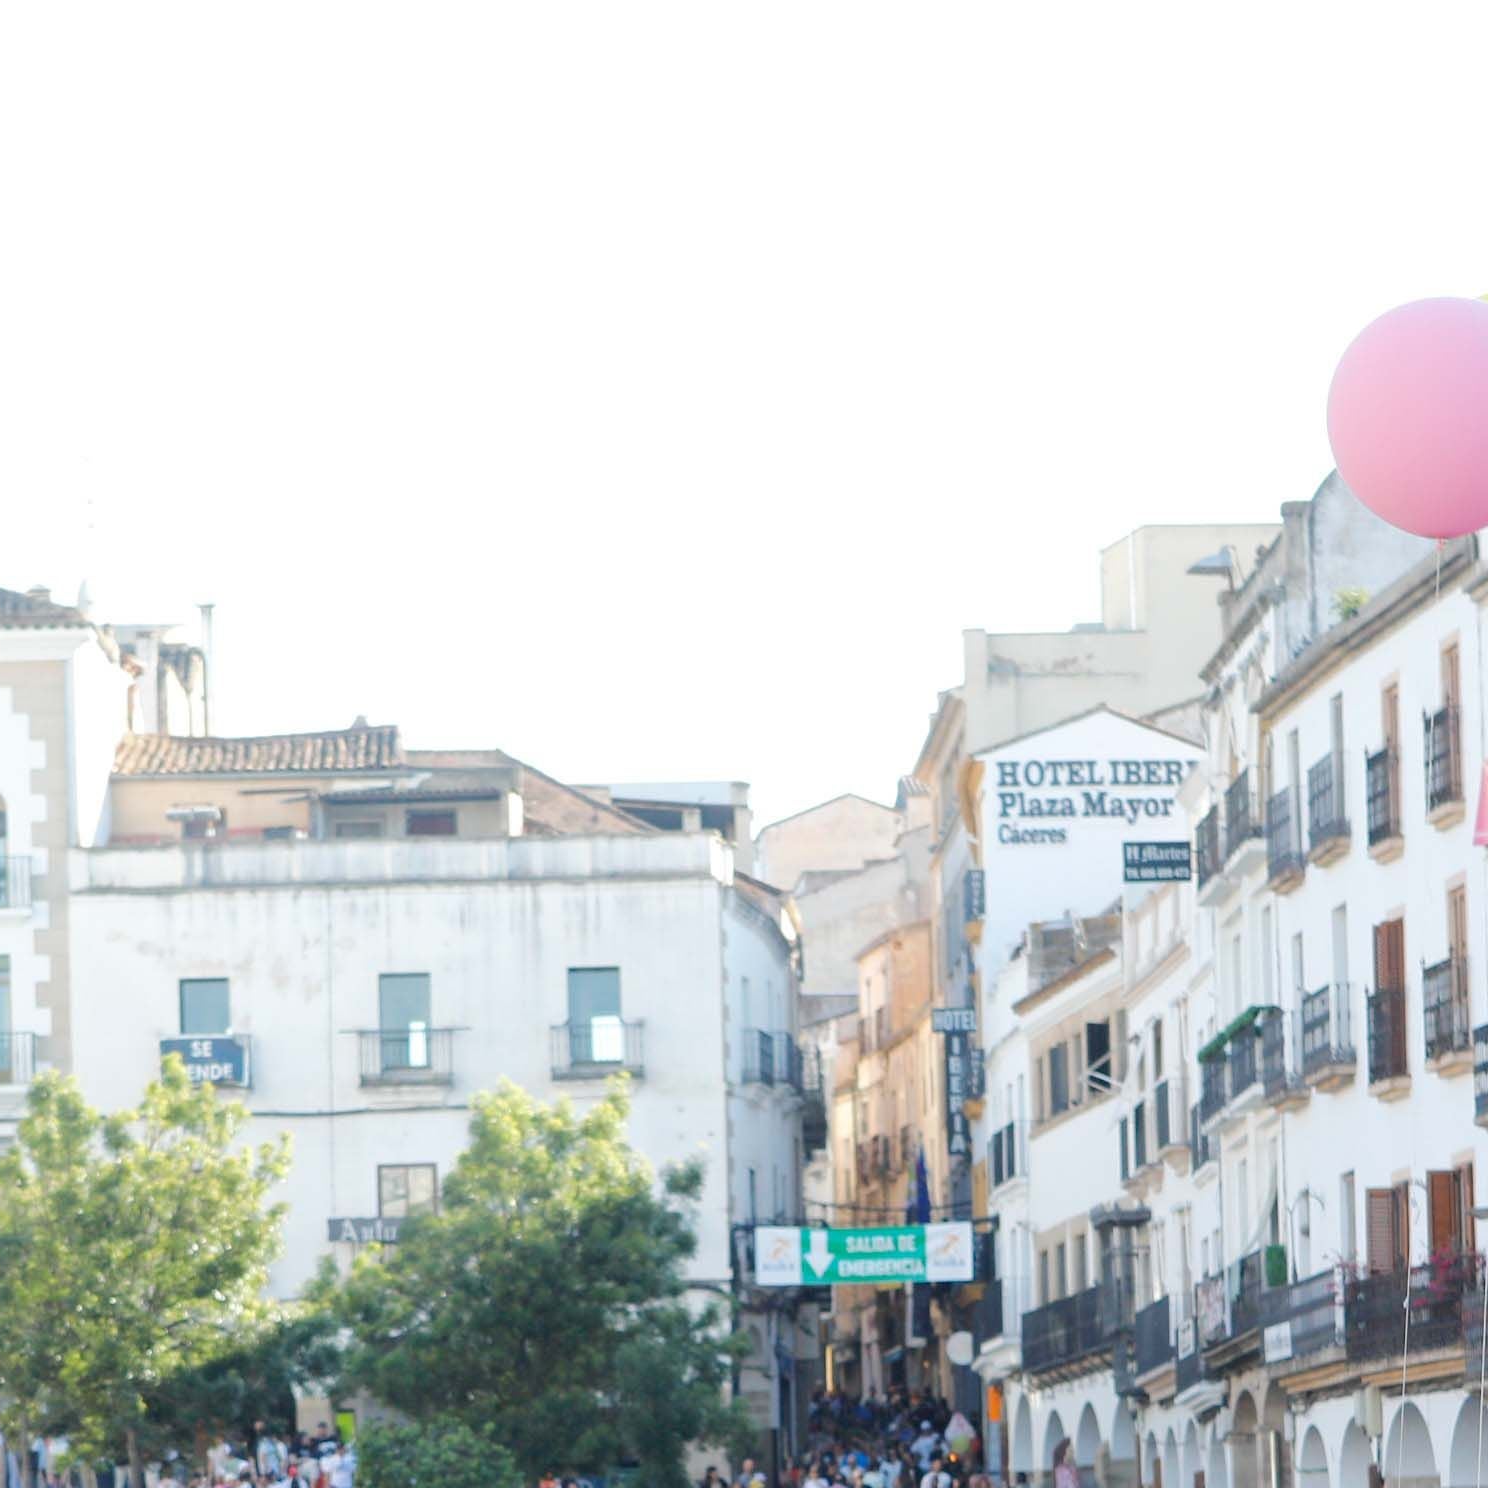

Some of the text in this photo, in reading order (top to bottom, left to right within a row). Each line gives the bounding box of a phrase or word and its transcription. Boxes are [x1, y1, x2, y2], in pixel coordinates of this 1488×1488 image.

[997, 760, 1200, 787] HOTEL IBER
[998, 793, 1174, 825] Plaza Mayor
[933, 1009, 975, 1032] HOTEL
[191, 1041, 213, 1058] SE
[186, 1062, 233, 1081] ENDE
[846, 1235, 916, 1253] SALIDA DE
[838, 1258, 924, 1277] EMERGENCIA
